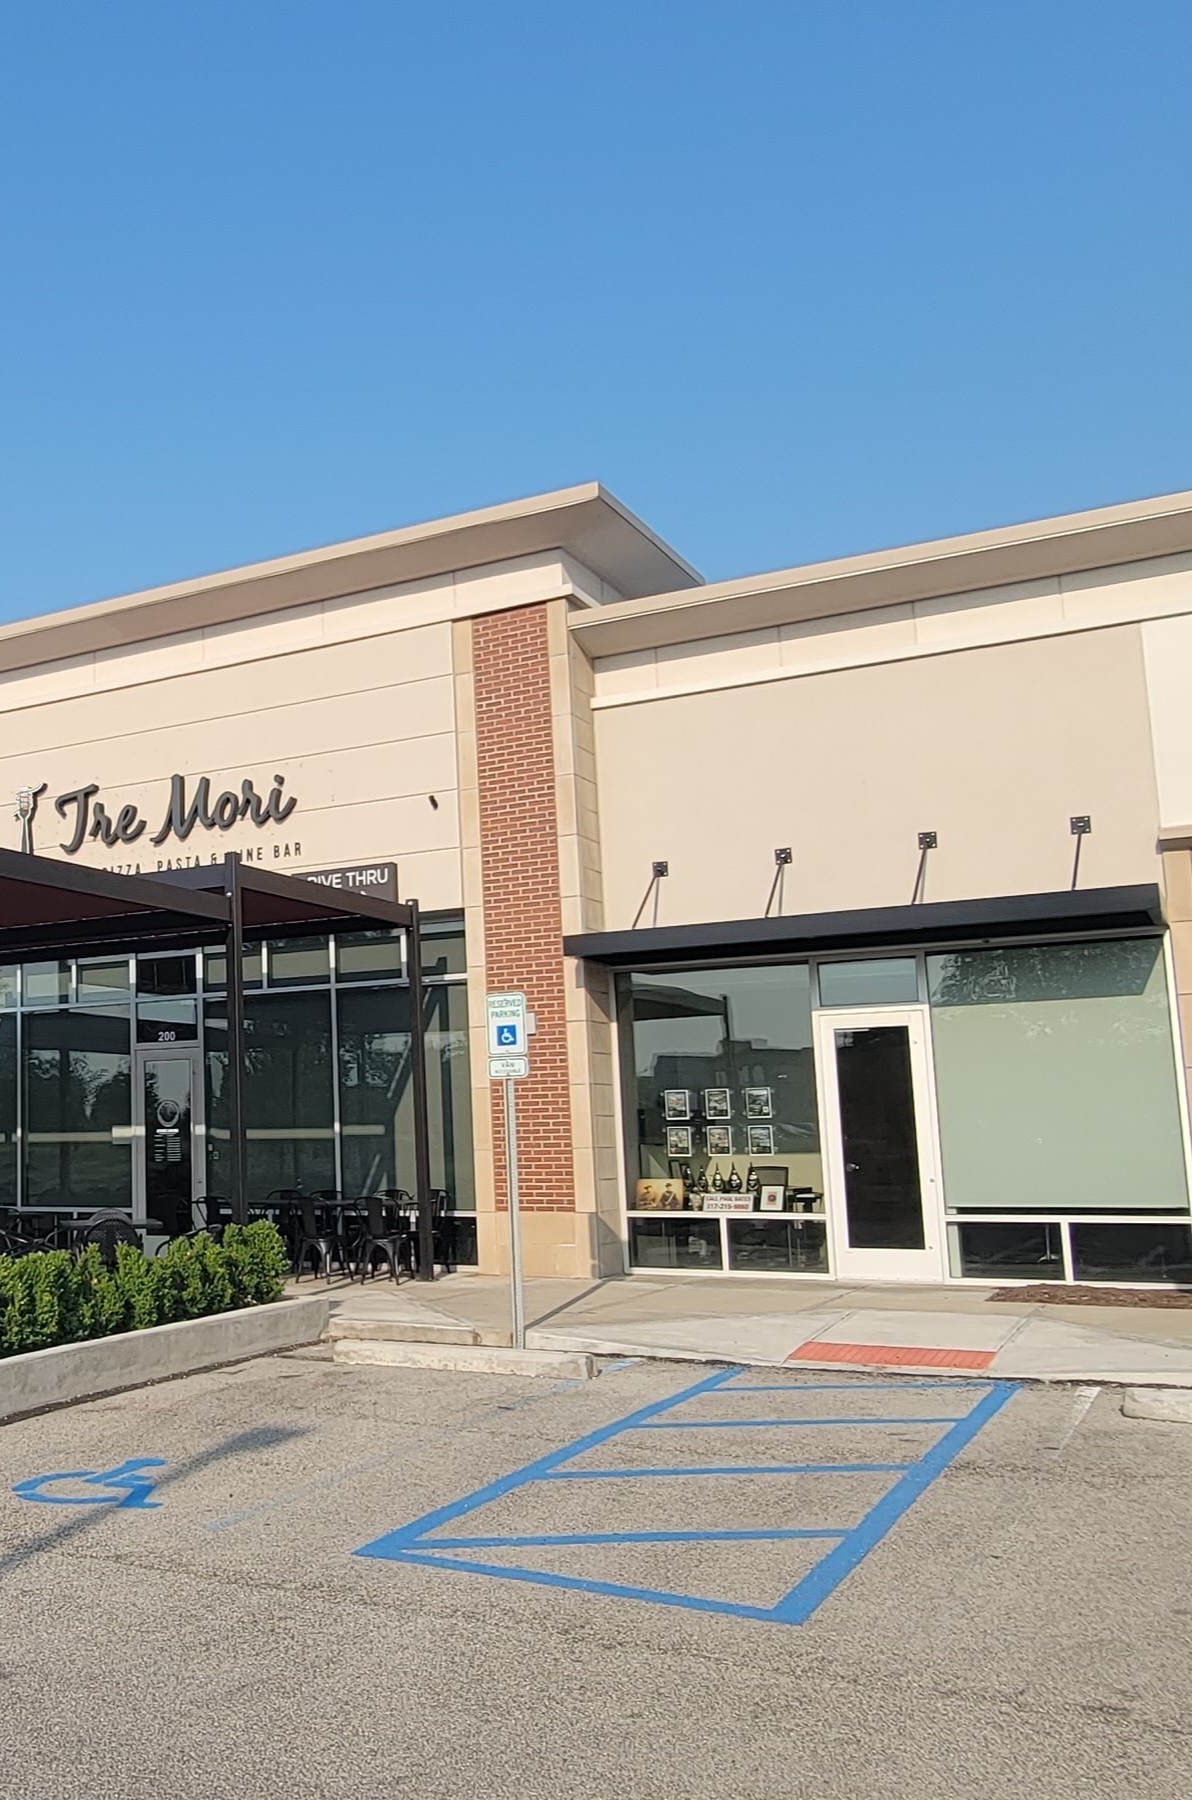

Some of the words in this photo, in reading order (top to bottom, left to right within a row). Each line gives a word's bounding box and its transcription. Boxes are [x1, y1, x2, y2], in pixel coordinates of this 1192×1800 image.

[55, 783, 147, 855] Tre
[149, 774, 297, 846] Mori
[102, 863, 140, 875] IZZA
[157, 855, 200, 872] PASTA
[210, 853, 217, 864] &
[273, 842, 301, 859] BAR
[307, 873, 342, 888] IVE
[345, 868, 388, 887] THRU
[488, 999, 522, 1008] RESERVED
[491, 1010, 520, 1018] PARKING
[158, 1031, 176, 1041] 200
